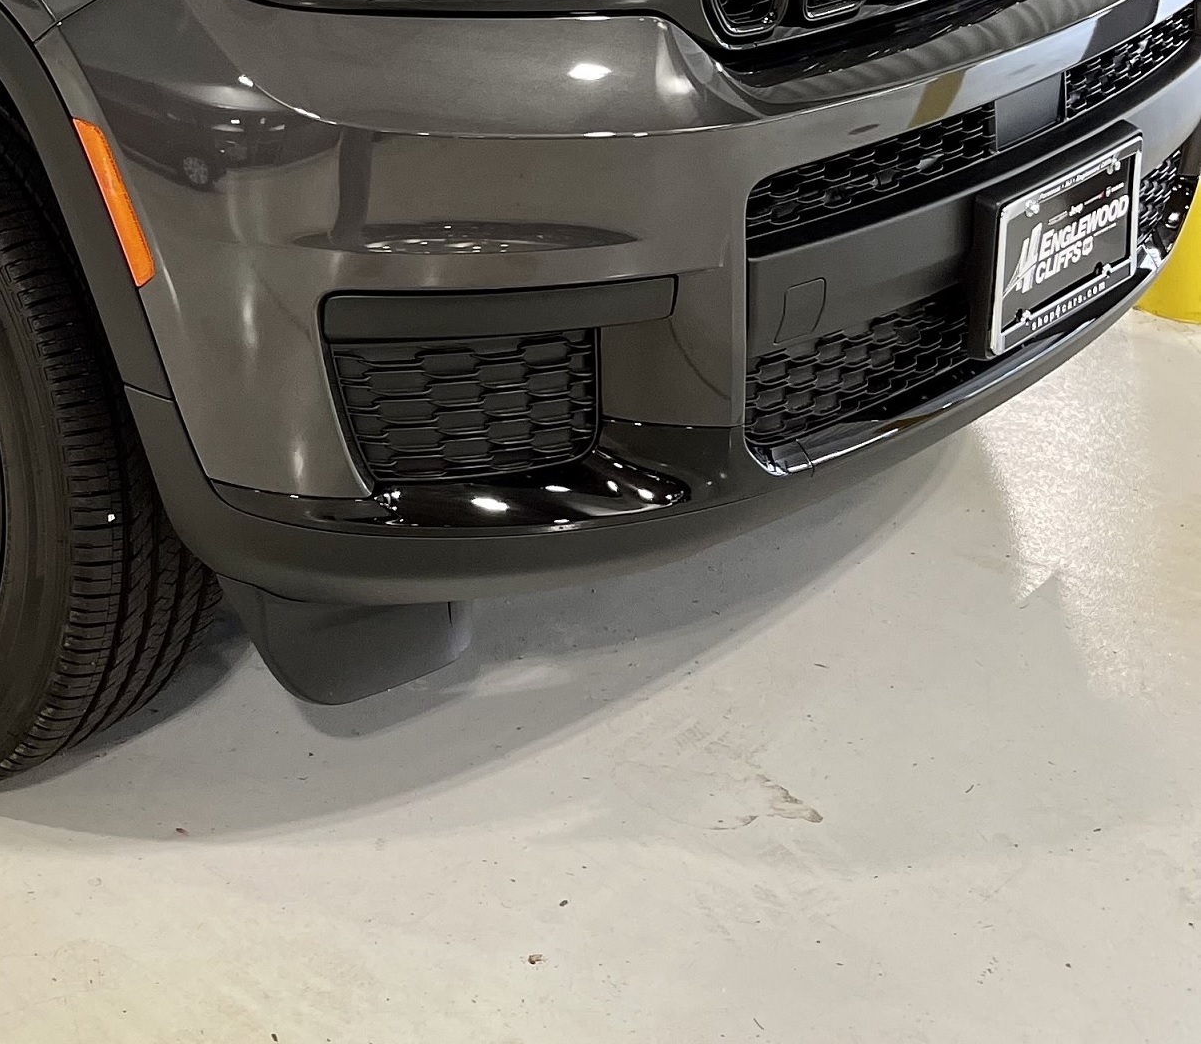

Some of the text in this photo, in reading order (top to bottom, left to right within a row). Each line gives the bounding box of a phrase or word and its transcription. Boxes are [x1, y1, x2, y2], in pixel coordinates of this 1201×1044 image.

[1039, 194, 1130, 257] ENGLEWOOD
[1035, 241, 1085, 285] CLIFFS
[1031, 280, 1106, 331] shop4cars.com
